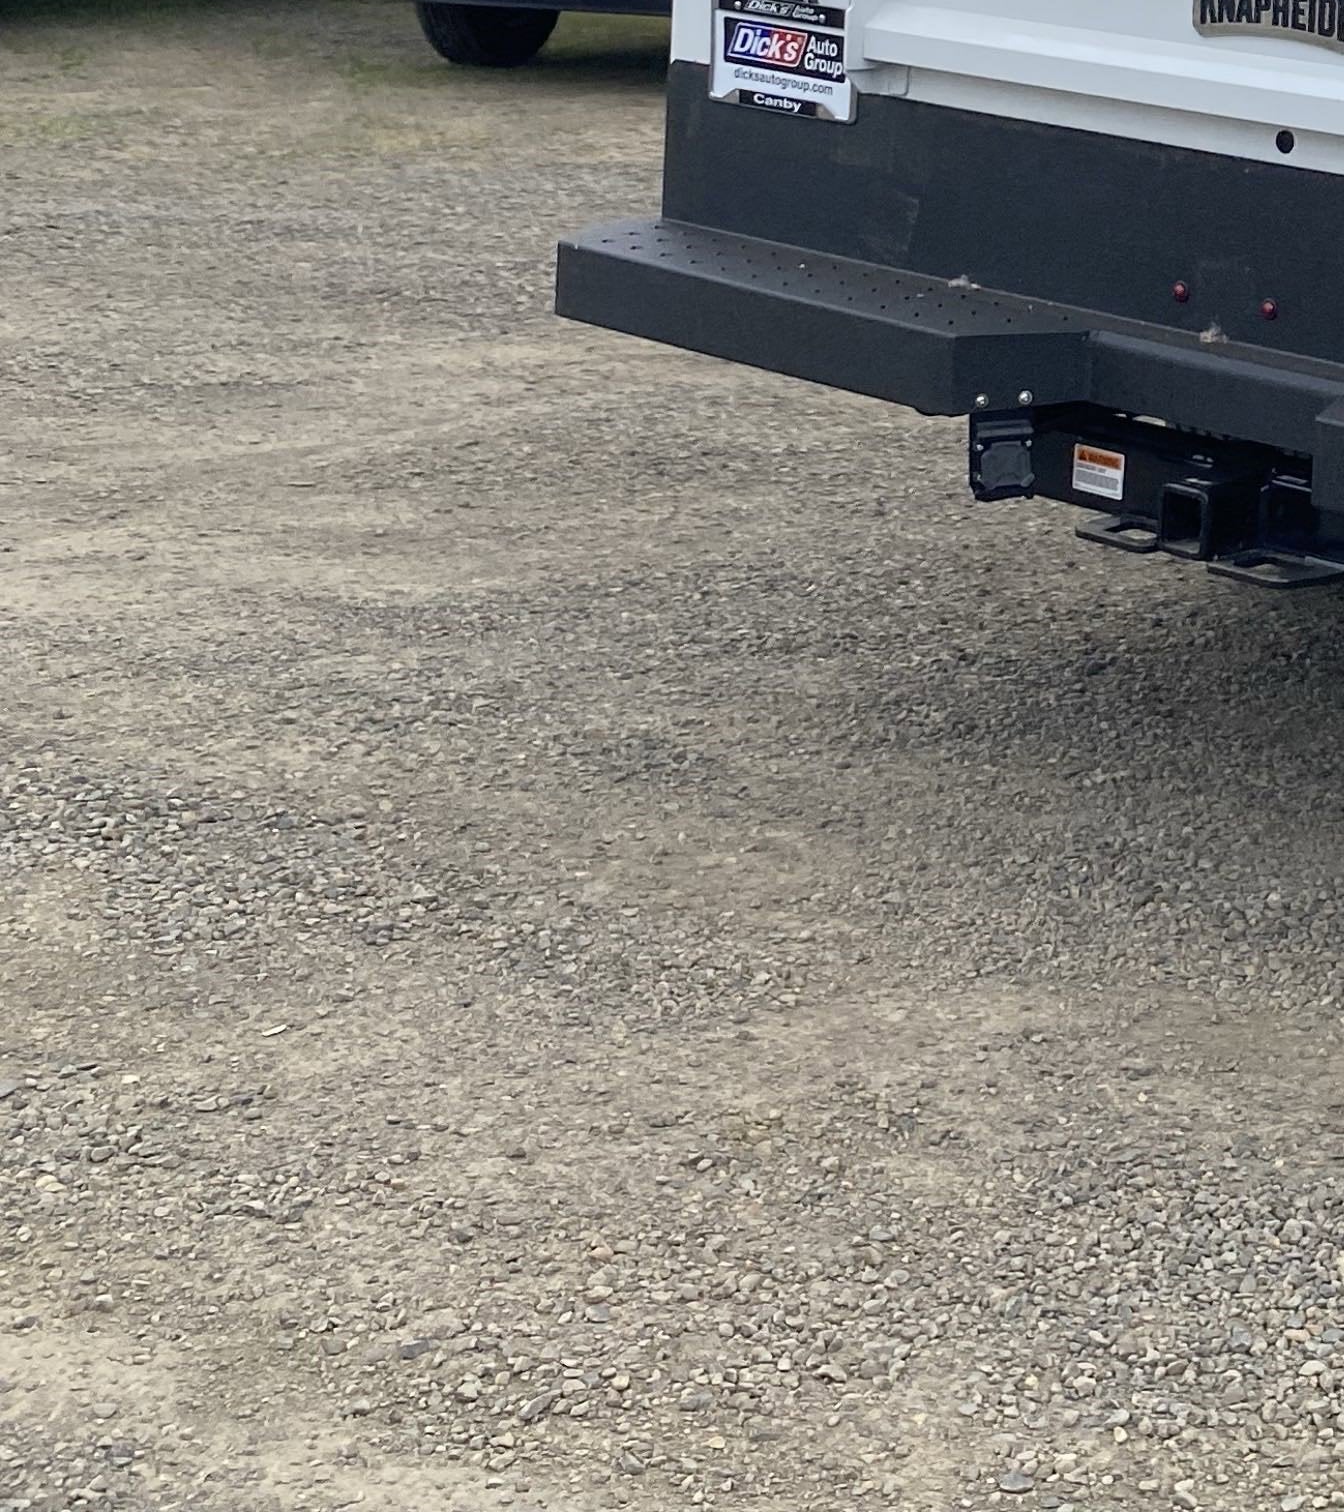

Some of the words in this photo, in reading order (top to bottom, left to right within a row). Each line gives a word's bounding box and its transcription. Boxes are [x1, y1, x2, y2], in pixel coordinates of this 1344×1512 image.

[747, 0, 789, 15] Dick's
[733, 27, 800, 62] Dick's
[806, 35, 838, 57] Auto
[804, 53, 843, 78] Group
[733, 66, 833, 96] dicksautogroup.com
[753, 92, 802, 113] Canby
